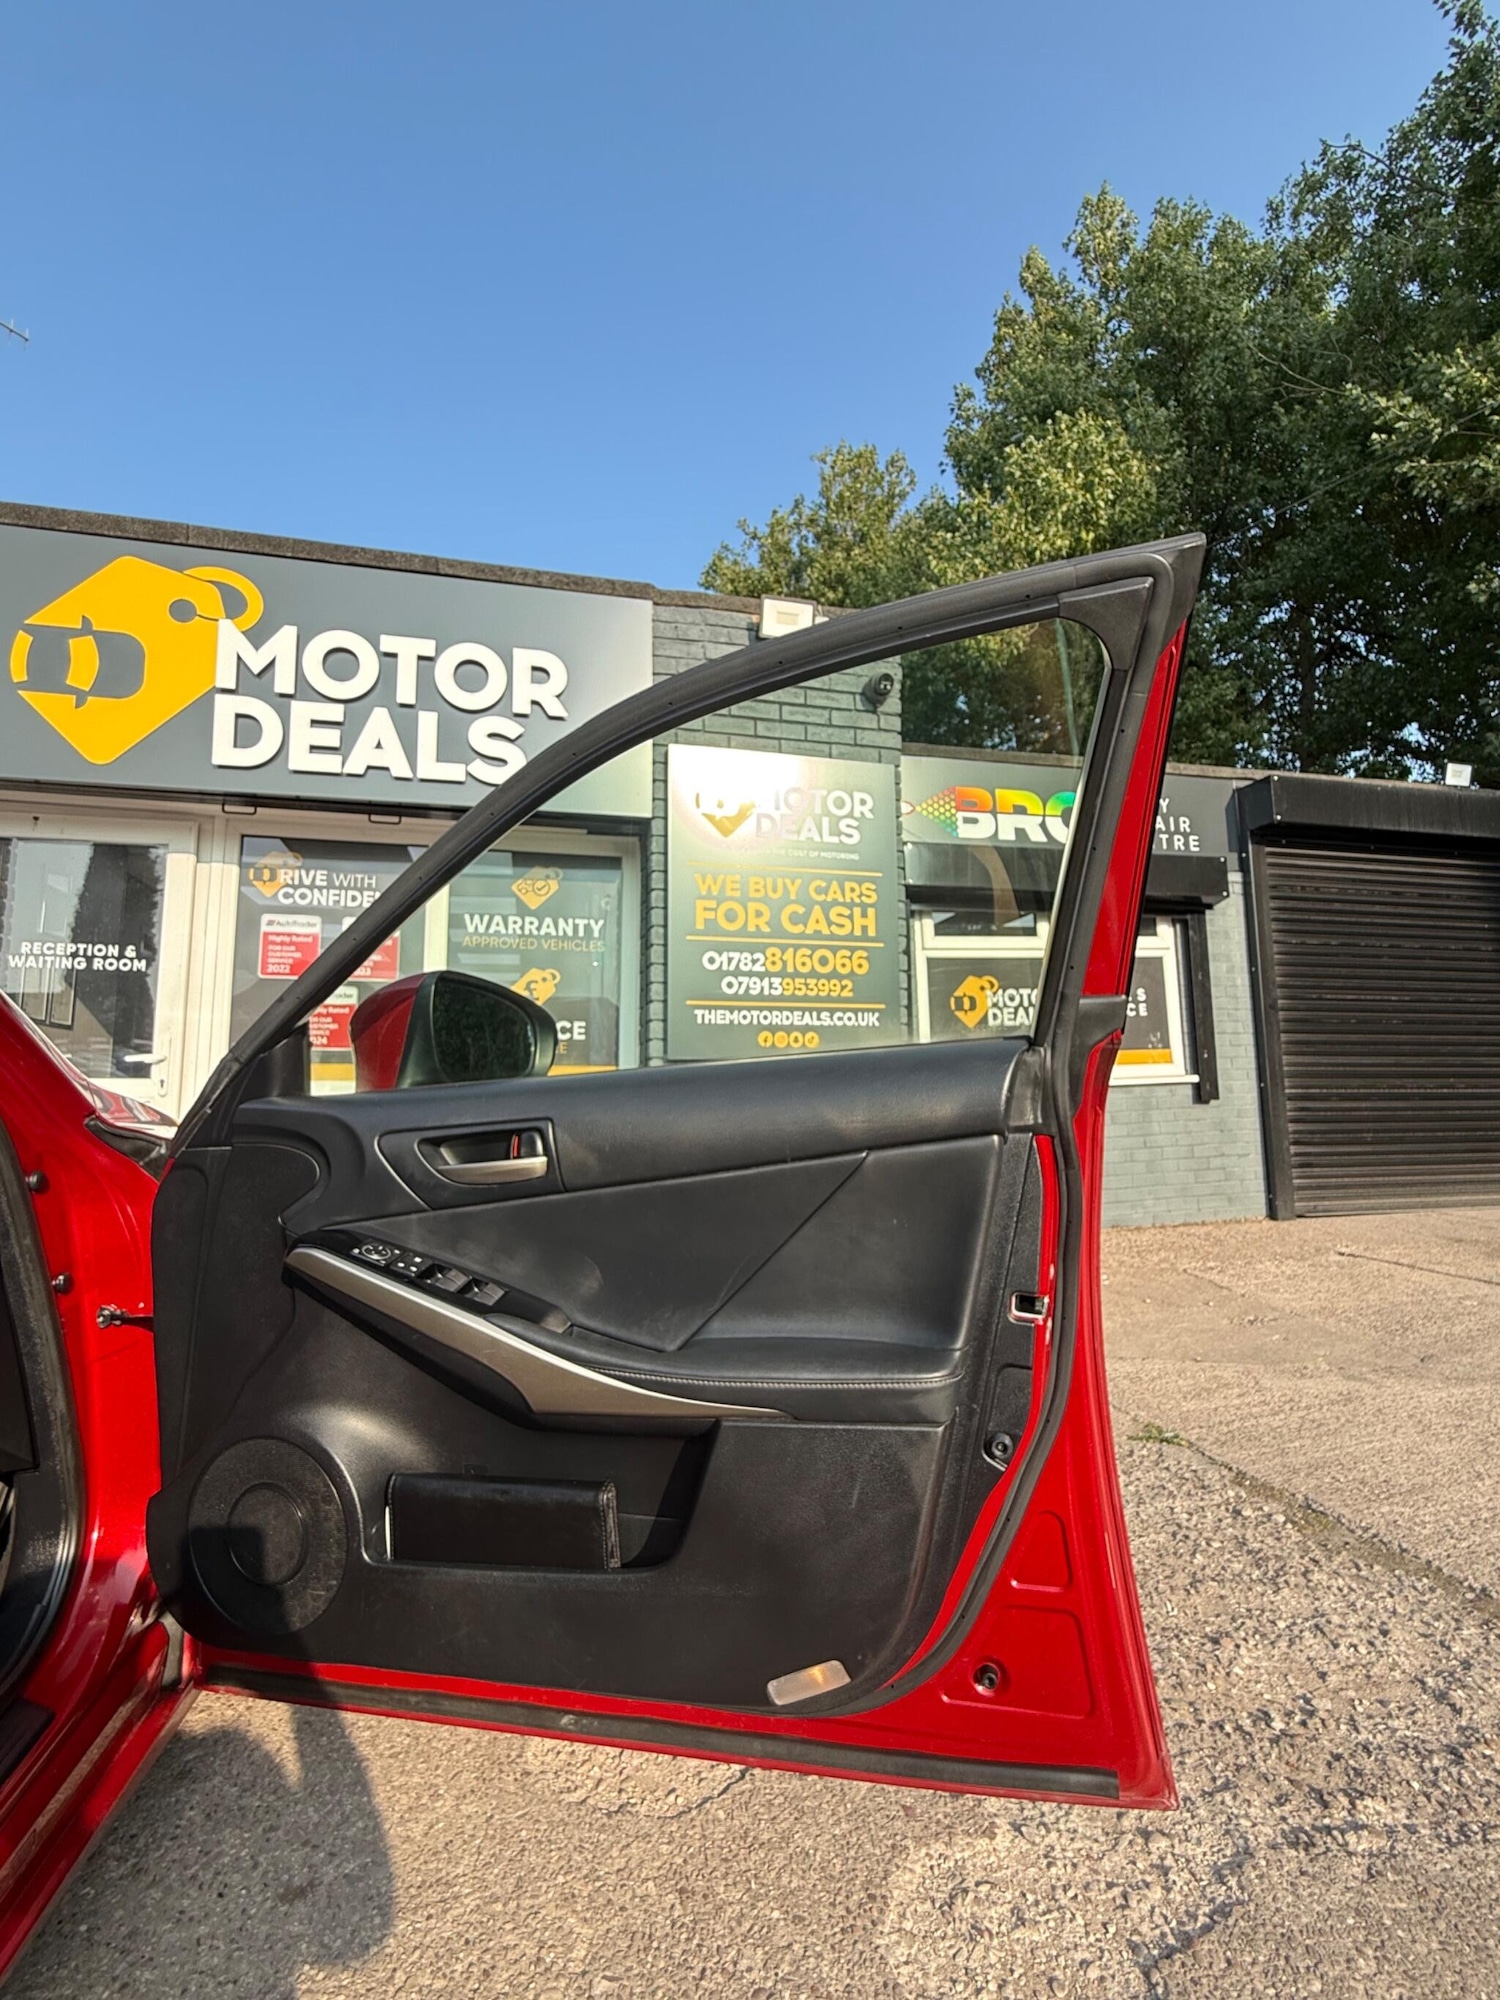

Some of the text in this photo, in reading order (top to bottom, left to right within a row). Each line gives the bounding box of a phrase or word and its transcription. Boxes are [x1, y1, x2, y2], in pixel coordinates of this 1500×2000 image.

[215, 618, 569, 719] MOTOR
[211, 693, 528, 786] DEALS
[756, 812, 861, 845] DEALS
[333, 873, 376, 888] WITH
[694, 873, 878, 904] WE BUY CARS
[463, 913, 605, 938] WARRANTY
[695, 899, 876, 936] FOR CASH
[20, 941, 137, 958] RECEPTION &
[462, 935, 606, 953] APPROVED VEHICLES
[8, 954, 147, 972] WAITING ROOM
[702, 946, 870, 975] 01782816066
[721, 976, 853, 997] 07913953992
[694, 1008, 880, 1027] THEMOTORDEALS.CO.UK
